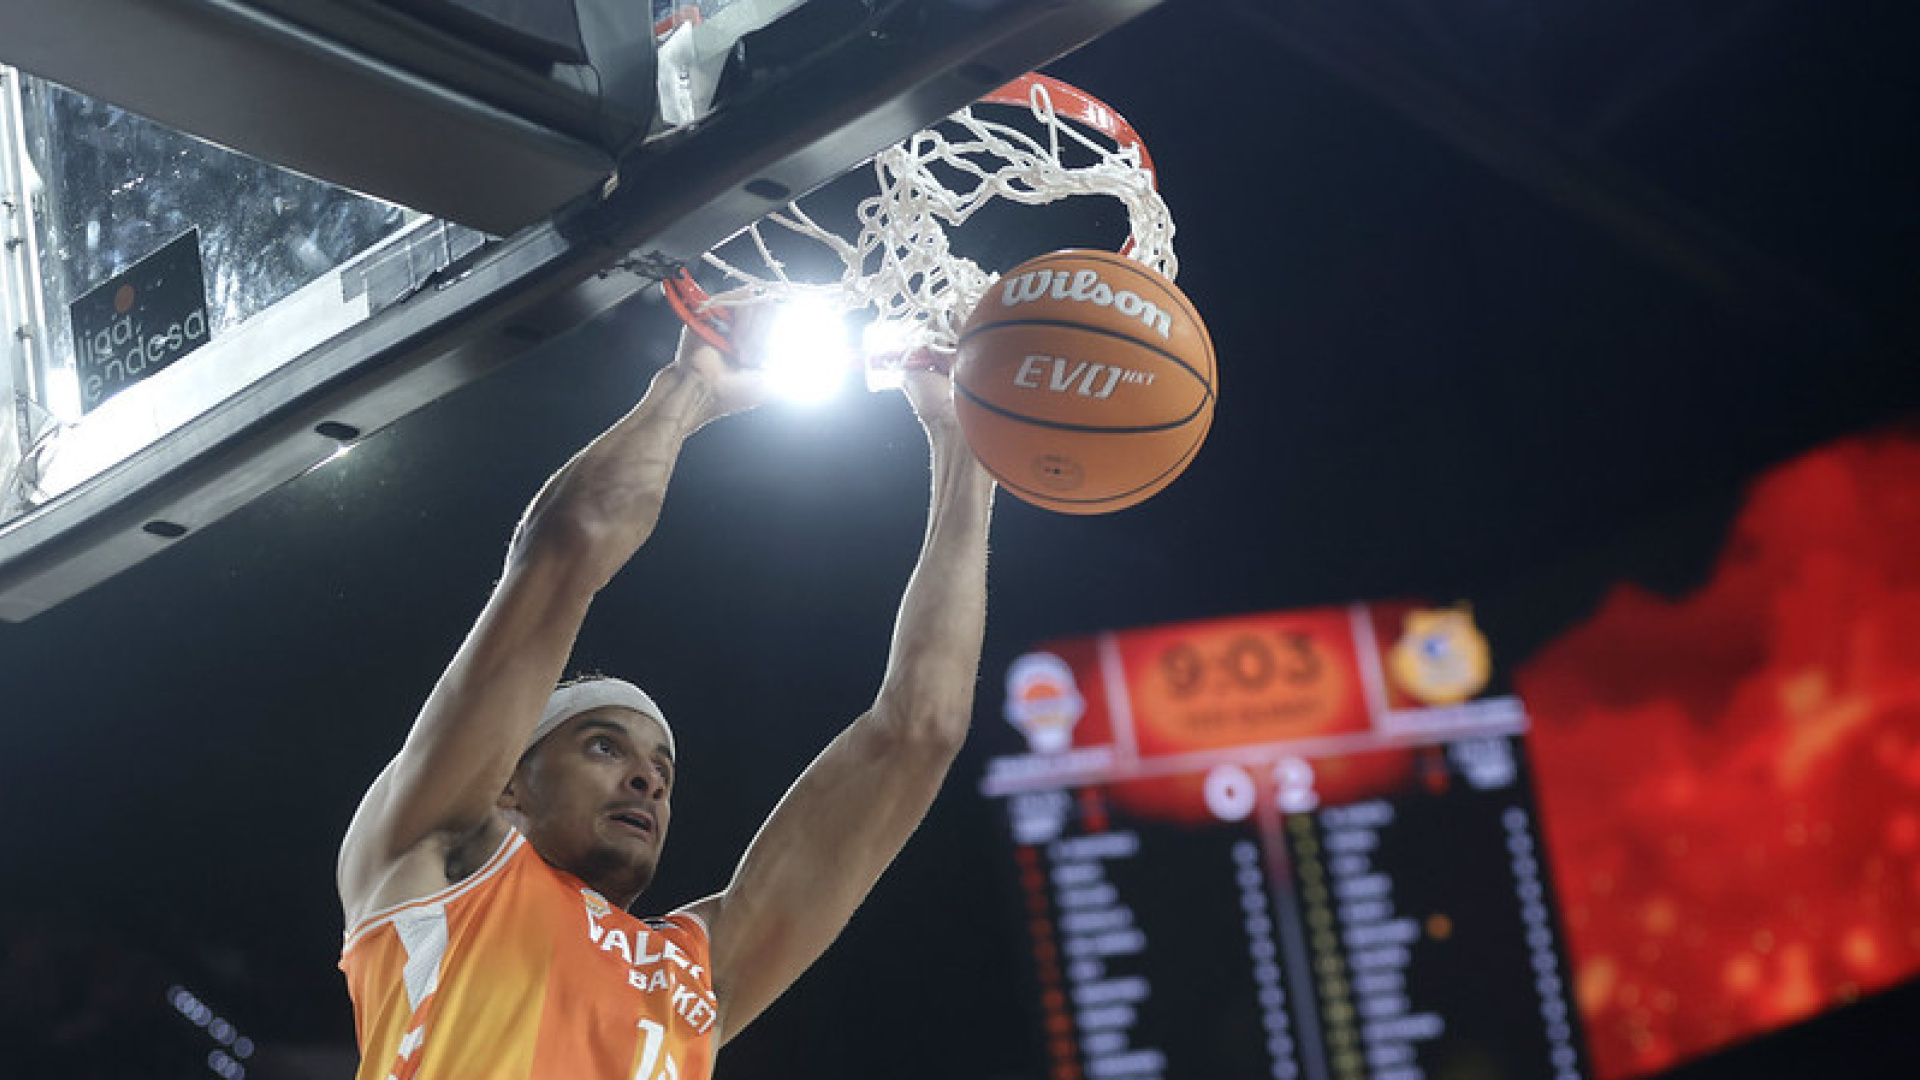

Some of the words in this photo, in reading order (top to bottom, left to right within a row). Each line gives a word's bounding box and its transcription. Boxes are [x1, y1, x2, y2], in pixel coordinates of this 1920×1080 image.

[1002, 268, 1173, 340] Wilson
[78, 313, 132, 367] liga
[87, 308, 206, 400] endesa
[1161, 632, 1323, 702] 9:03
[1204, 763, 1257, 820] 0
[1273, 755, 1320, 815] 2
